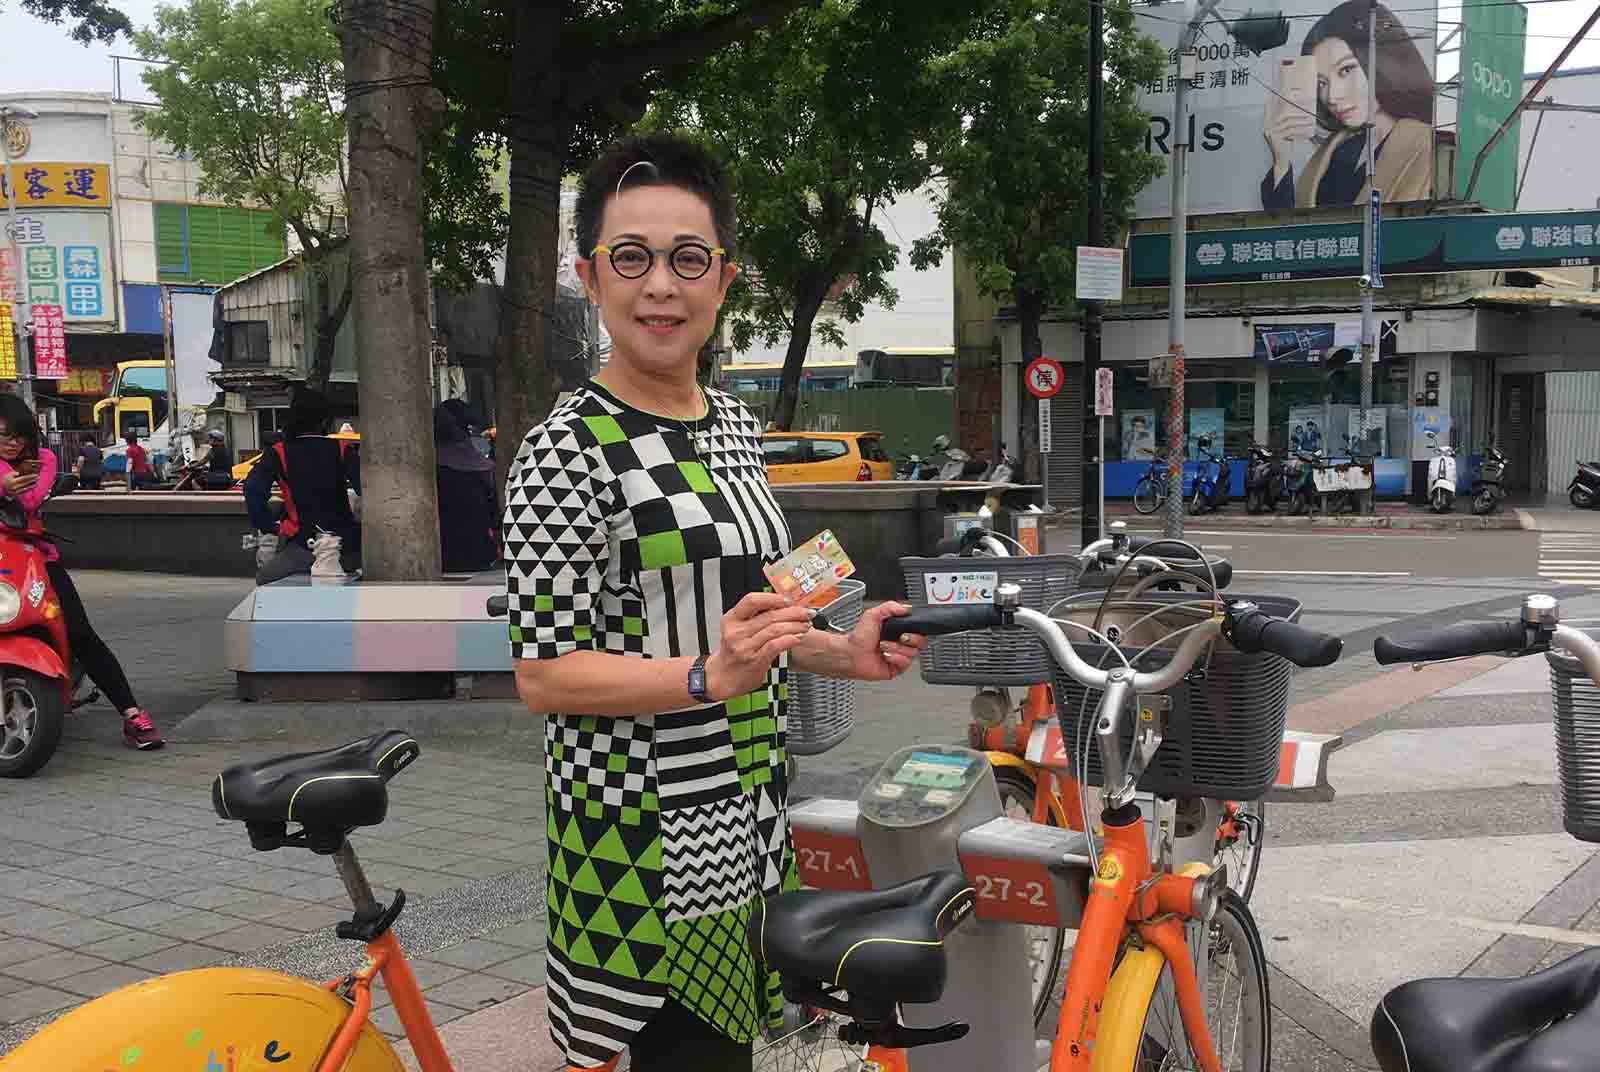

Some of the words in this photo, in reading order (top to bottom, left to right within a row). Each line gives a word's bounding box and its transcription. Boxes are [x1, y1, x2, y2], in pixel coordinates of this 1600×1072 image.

[1231, 236, 1360, 264] 聯強電信聯盟
[800, 847, 860, 880] 27-1
[975, 874, 1049, 907] 27-2
